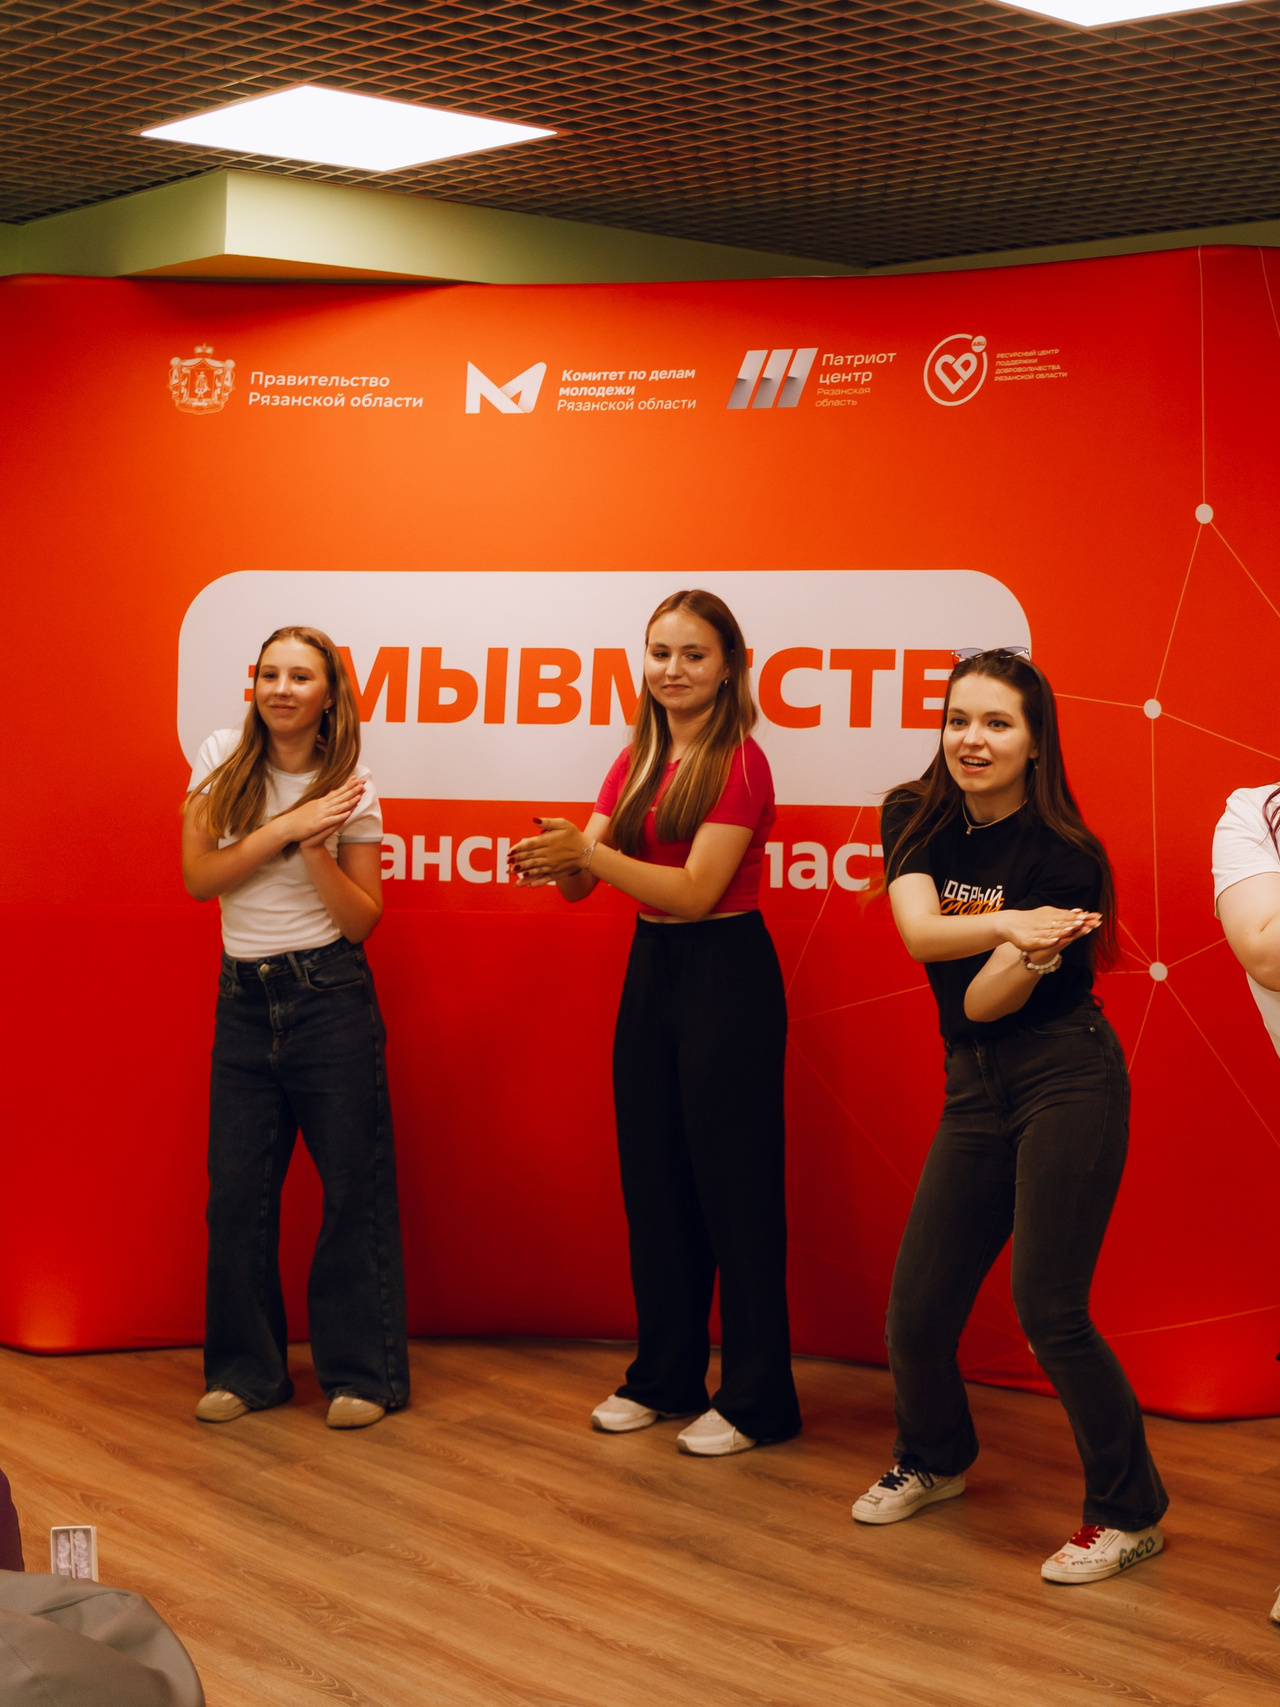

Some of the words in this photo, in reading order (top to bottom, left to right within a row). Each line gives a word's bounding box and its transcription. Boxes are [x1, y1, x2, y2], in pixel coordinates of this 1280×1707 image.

[821, 352, 897, 367] Патриот
[1037, 348, 1059, 356] ЦЕНТР
[250, 371, 390, 388] Правительство
[561, 369, 626, 382] Комитет
[628, 370, 647, 381] по
[649, 367, 696, 381] делам
[819, 371, 873, 386] центр
[1035, 371, 1068, 379] ОБЛАСТИ
[558, 385, 636, 397] молодежи
[816, 387, 871, 396] Рязанская
[248, 391, 346, 407] Рязанской
[350, 393, 424, 408] области
[556, 397, 634, 412] Рязанской
[637, 397, 697, 411] области
[815, 398, 857, 408] область
[244, 646, 955, 730] МЫВМСТЕ
[941, 879, 1004, 907] ОБРЫЙ
